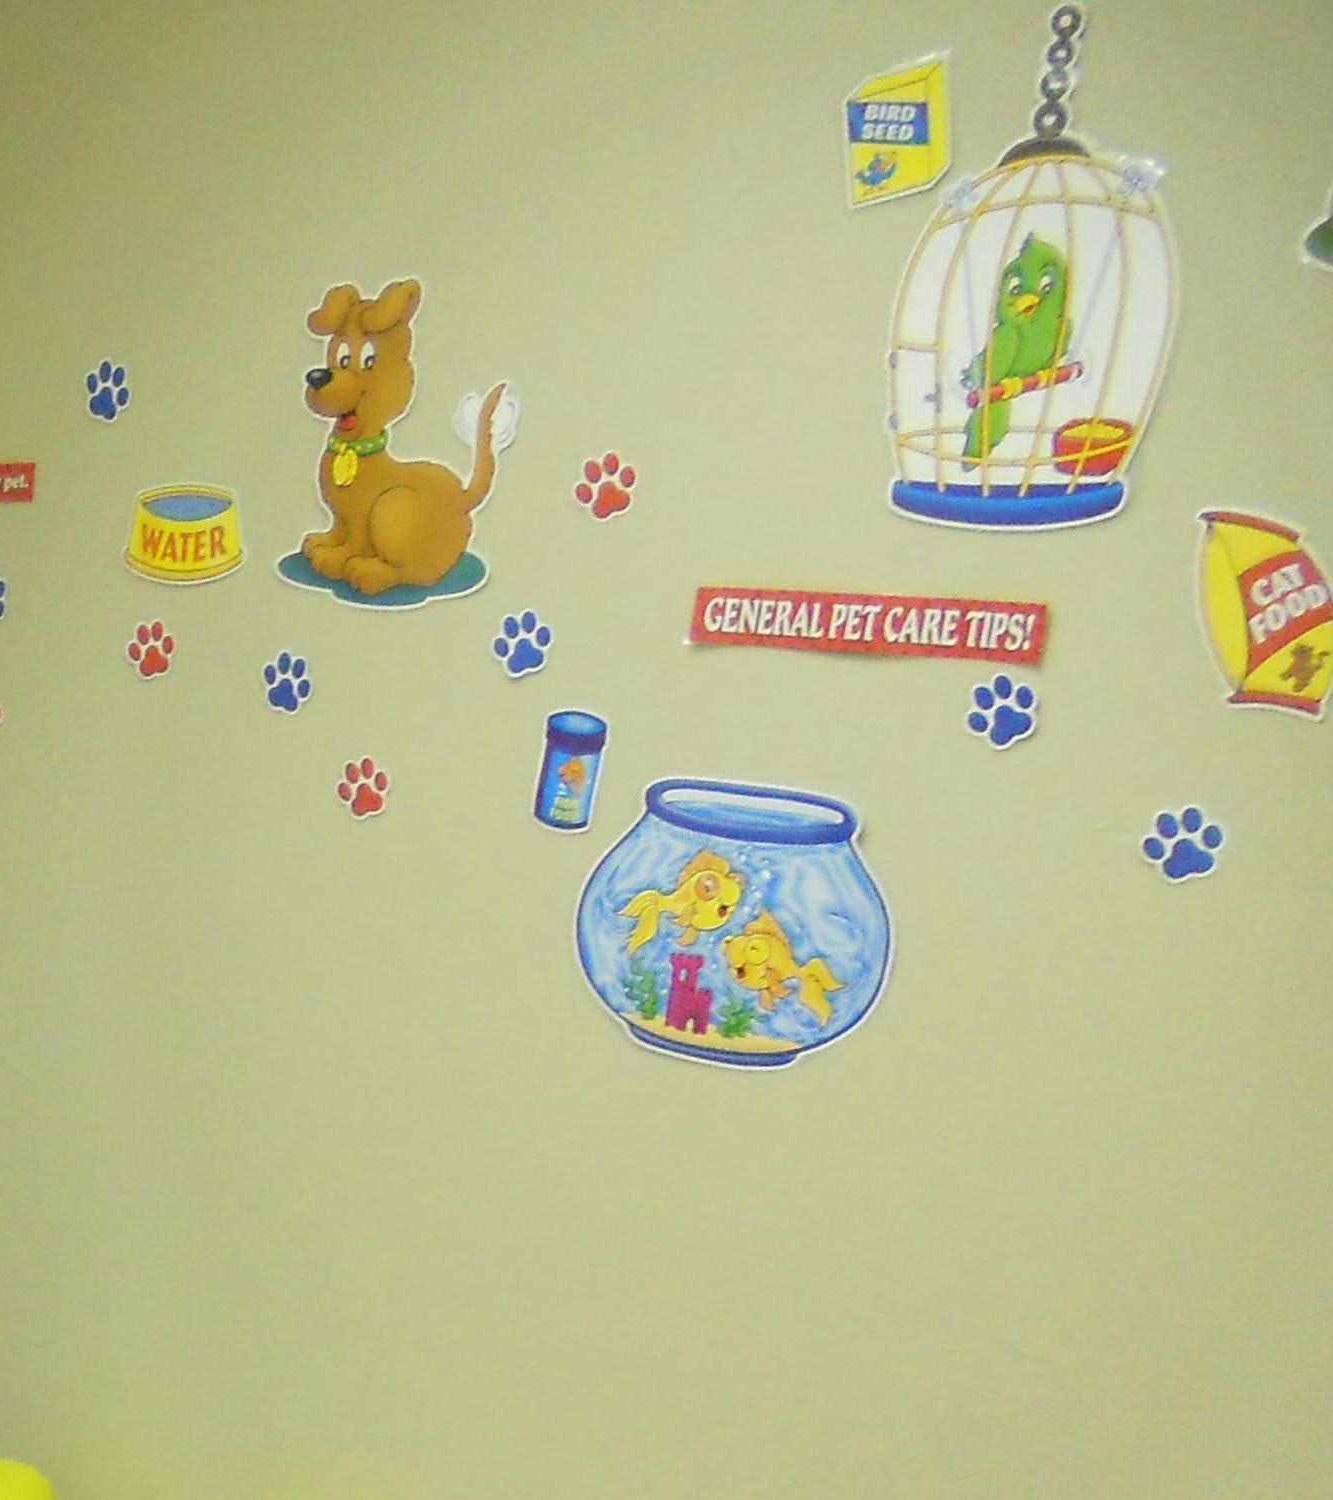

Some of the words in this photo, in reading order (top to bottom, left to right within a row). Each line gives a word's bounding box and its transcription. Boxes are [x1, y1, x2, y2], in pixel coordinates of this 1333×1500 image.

[861, 123, 914, 141] SEED
[864, 103, 917, 122] BIRD
[3, 474, 30, 493] pet.
[141, 523, 227, 563] WATER
[1250, 562, 1304, 606] CAT
[702, 597, 826, 640] GENERAL
[827, 603, 882, 642] PET
[883, 606, 962, 647] CARE
[964, 610, 1037, 651] TIPS!
[1249, 583, 1330, 645] FOOD
